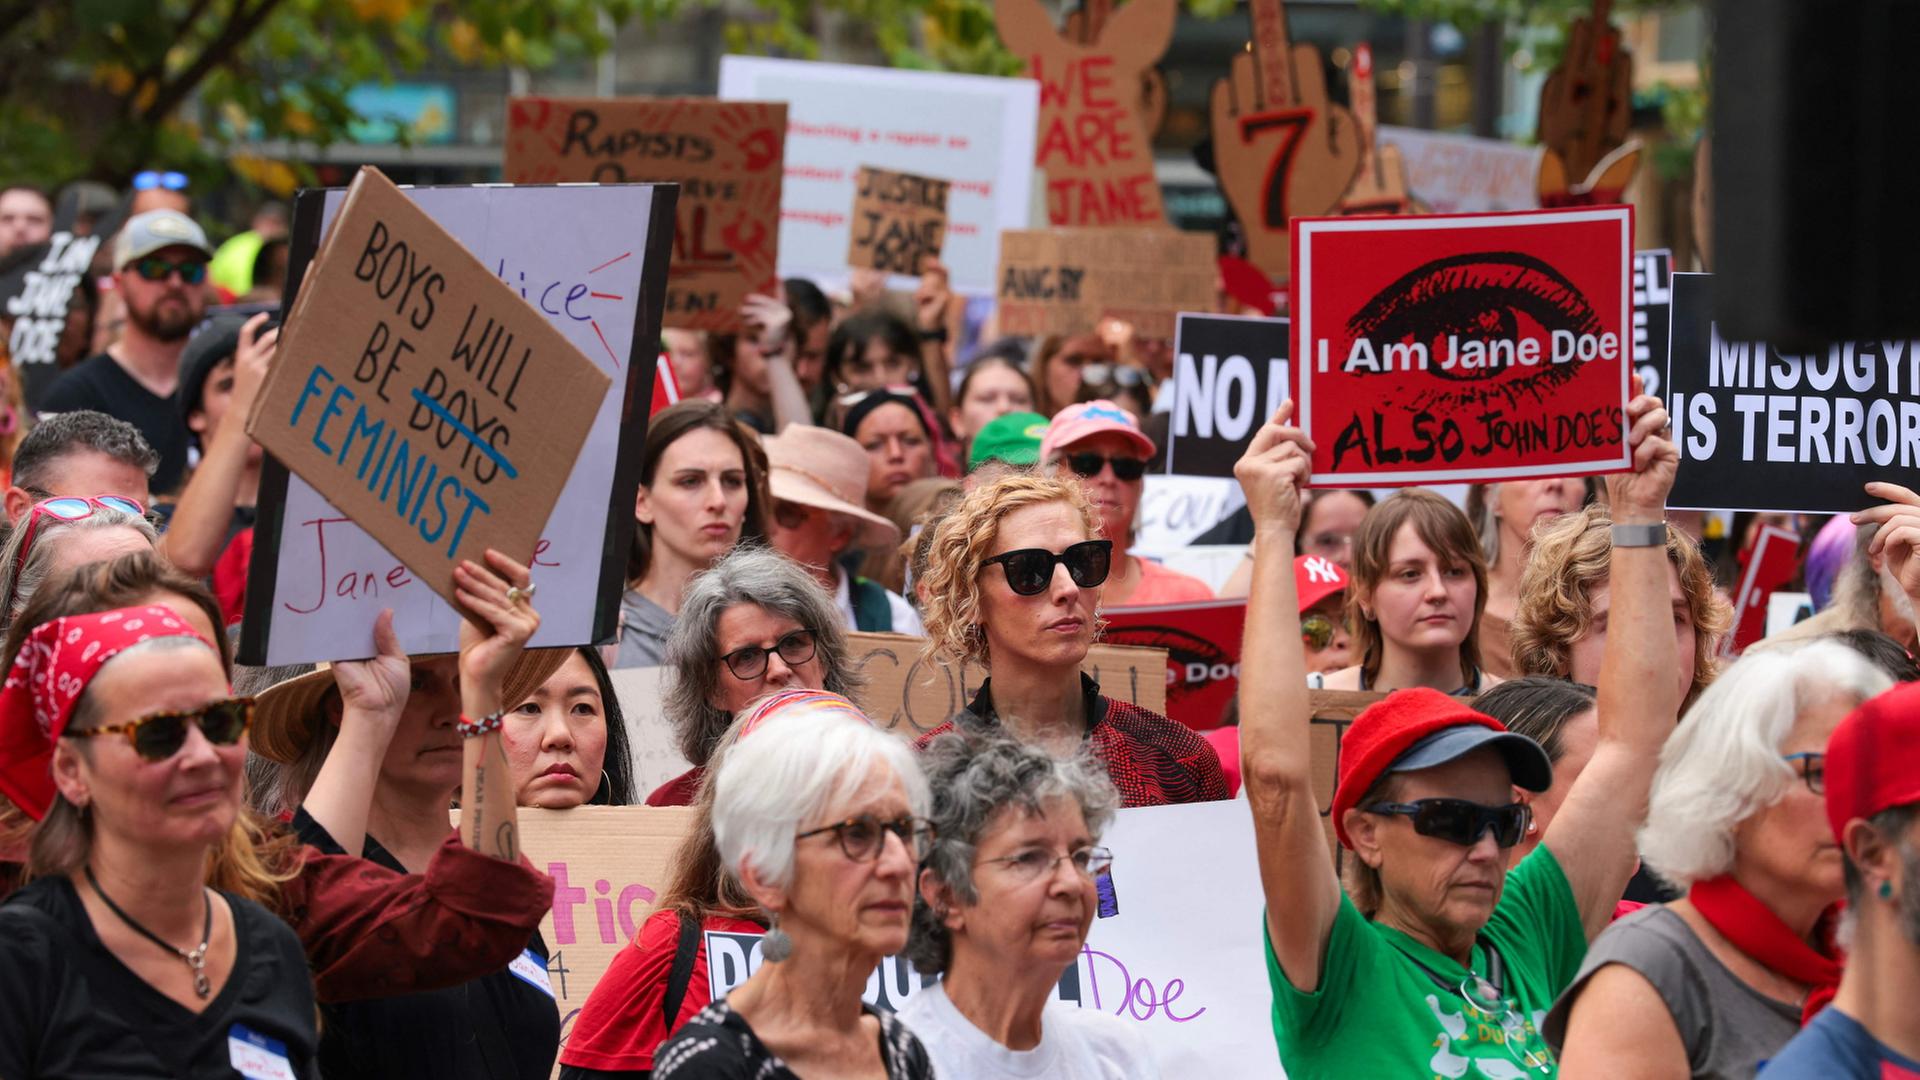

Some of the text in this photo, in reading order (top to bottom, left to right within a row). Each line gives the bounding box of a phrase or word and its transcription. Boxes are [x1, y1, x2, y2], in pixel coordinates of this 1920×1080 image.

[1030, 54, 1117, 108] WE
[1035, 110, 1135, 169] ARE
[1238, 107, 1315, 229] 7
[1048, 173, 1160, 226] JANE
[354, 221, 532, 413] BOYS WILL
[1317, 329, 1619, 373] I Am Jane Doe
[353, 321, 511, 485] BE BOYS
[1174, 352, 1258, 442] NO
[1671, 391, 1718, 462] IS
[290, 364, 491, 560] FEMINIST
[1331, 404, 1624, 472] ALSO JOHN DOE'S
[284, 518, 412, 614] Jane
[1079, 942, 1207, 1023] Doe
